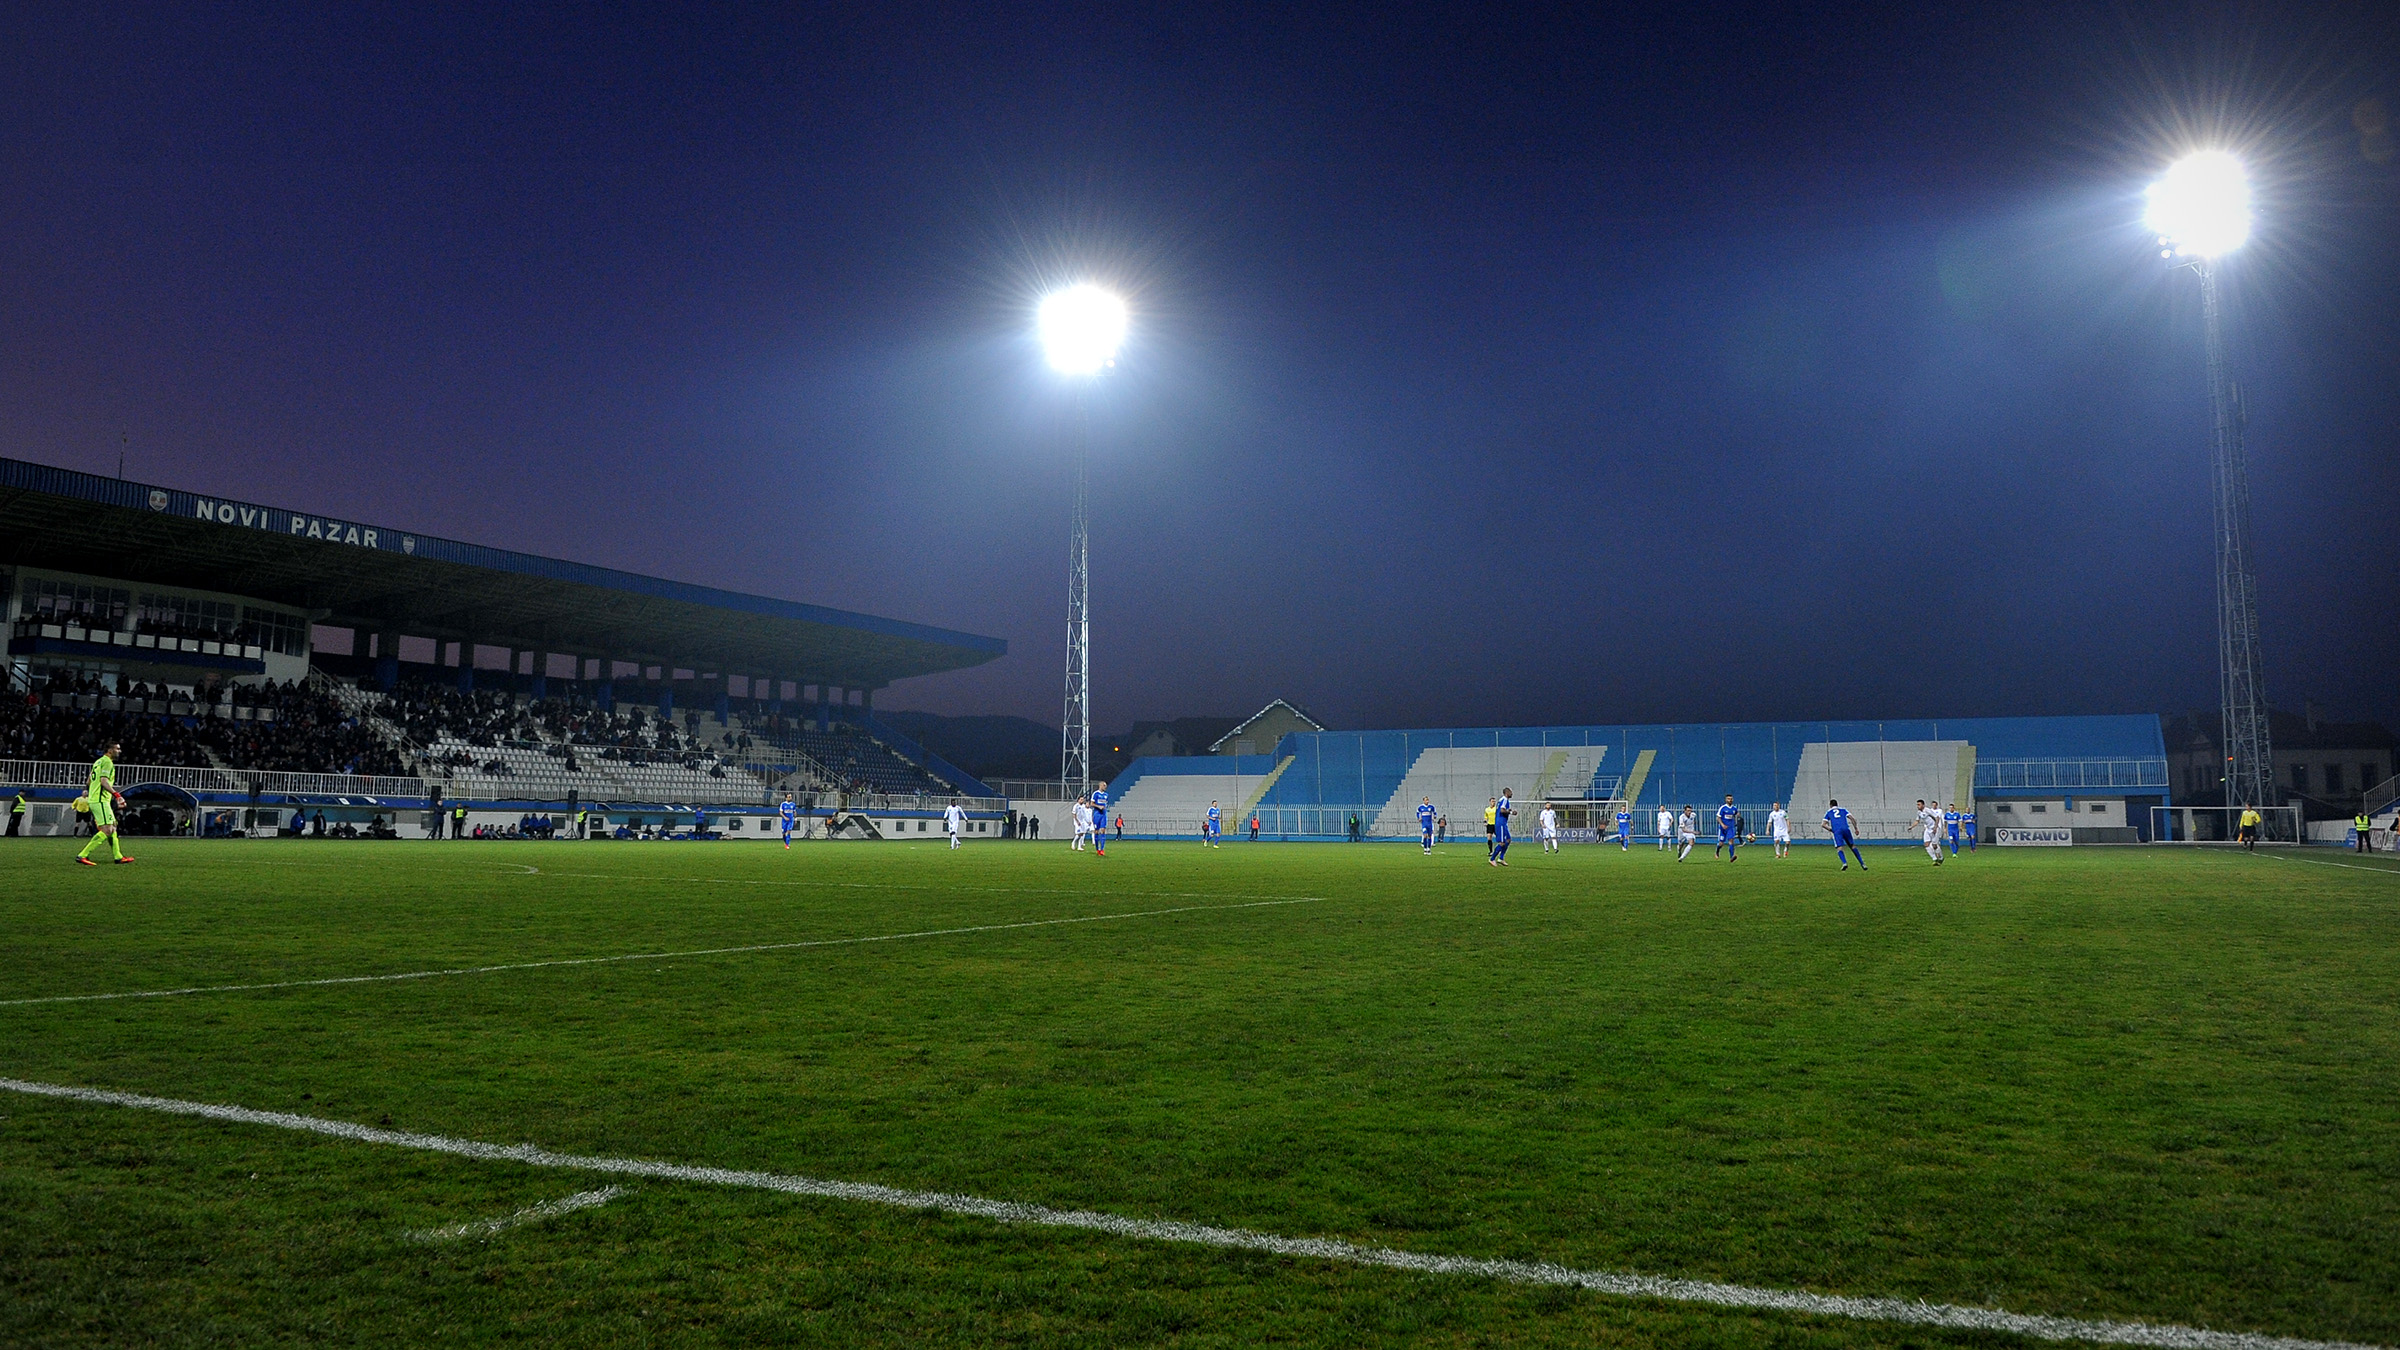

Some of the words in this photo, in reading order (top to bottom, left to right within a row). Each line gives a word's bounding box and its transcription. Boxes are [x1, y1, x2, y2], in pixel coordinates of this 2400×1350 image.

[196, 500, 268, 529] NOVI
[291, 516, 378, 548] PAZAR
[1833, 809, 1841, 818] 2
[2010, 831, 2069, 841] TRAVIO
